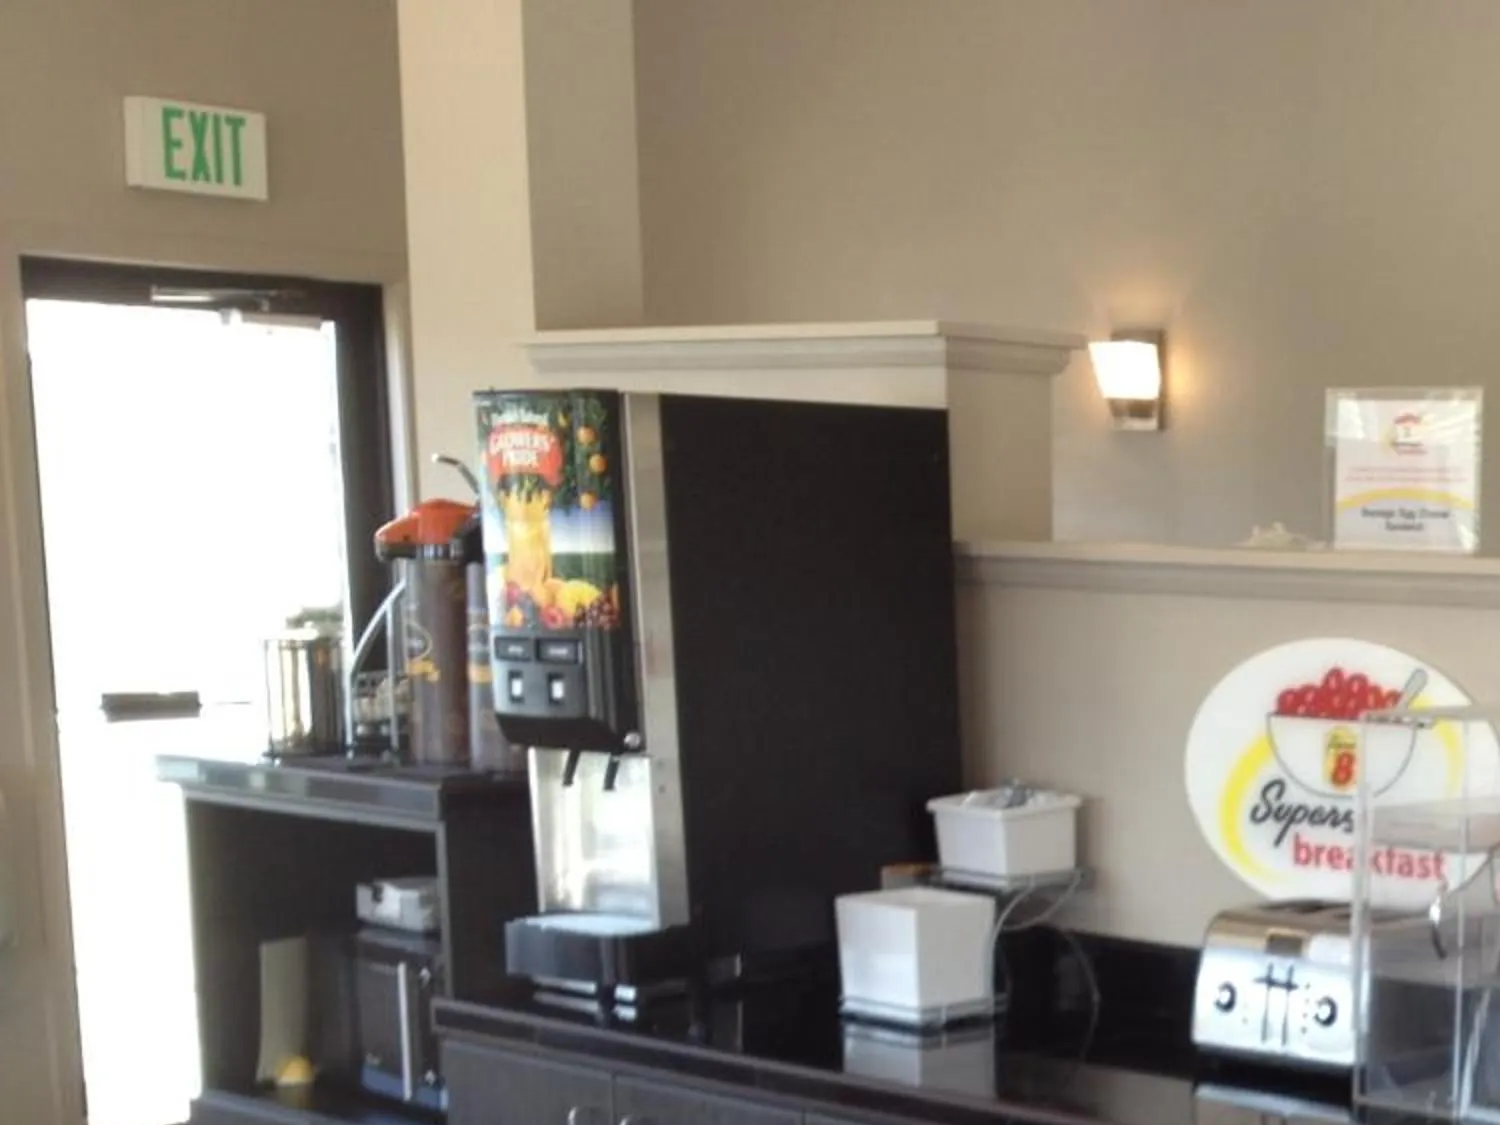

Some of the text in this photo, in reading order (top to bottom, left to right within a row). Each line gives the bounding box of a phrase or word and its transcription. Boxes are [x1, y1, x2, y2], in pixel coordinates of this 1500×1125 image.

[162, 105, 246, 187] EXIT
[1250, 777, 1355, 847] Supers
[1292, 832, 1447, 880] brekfast
